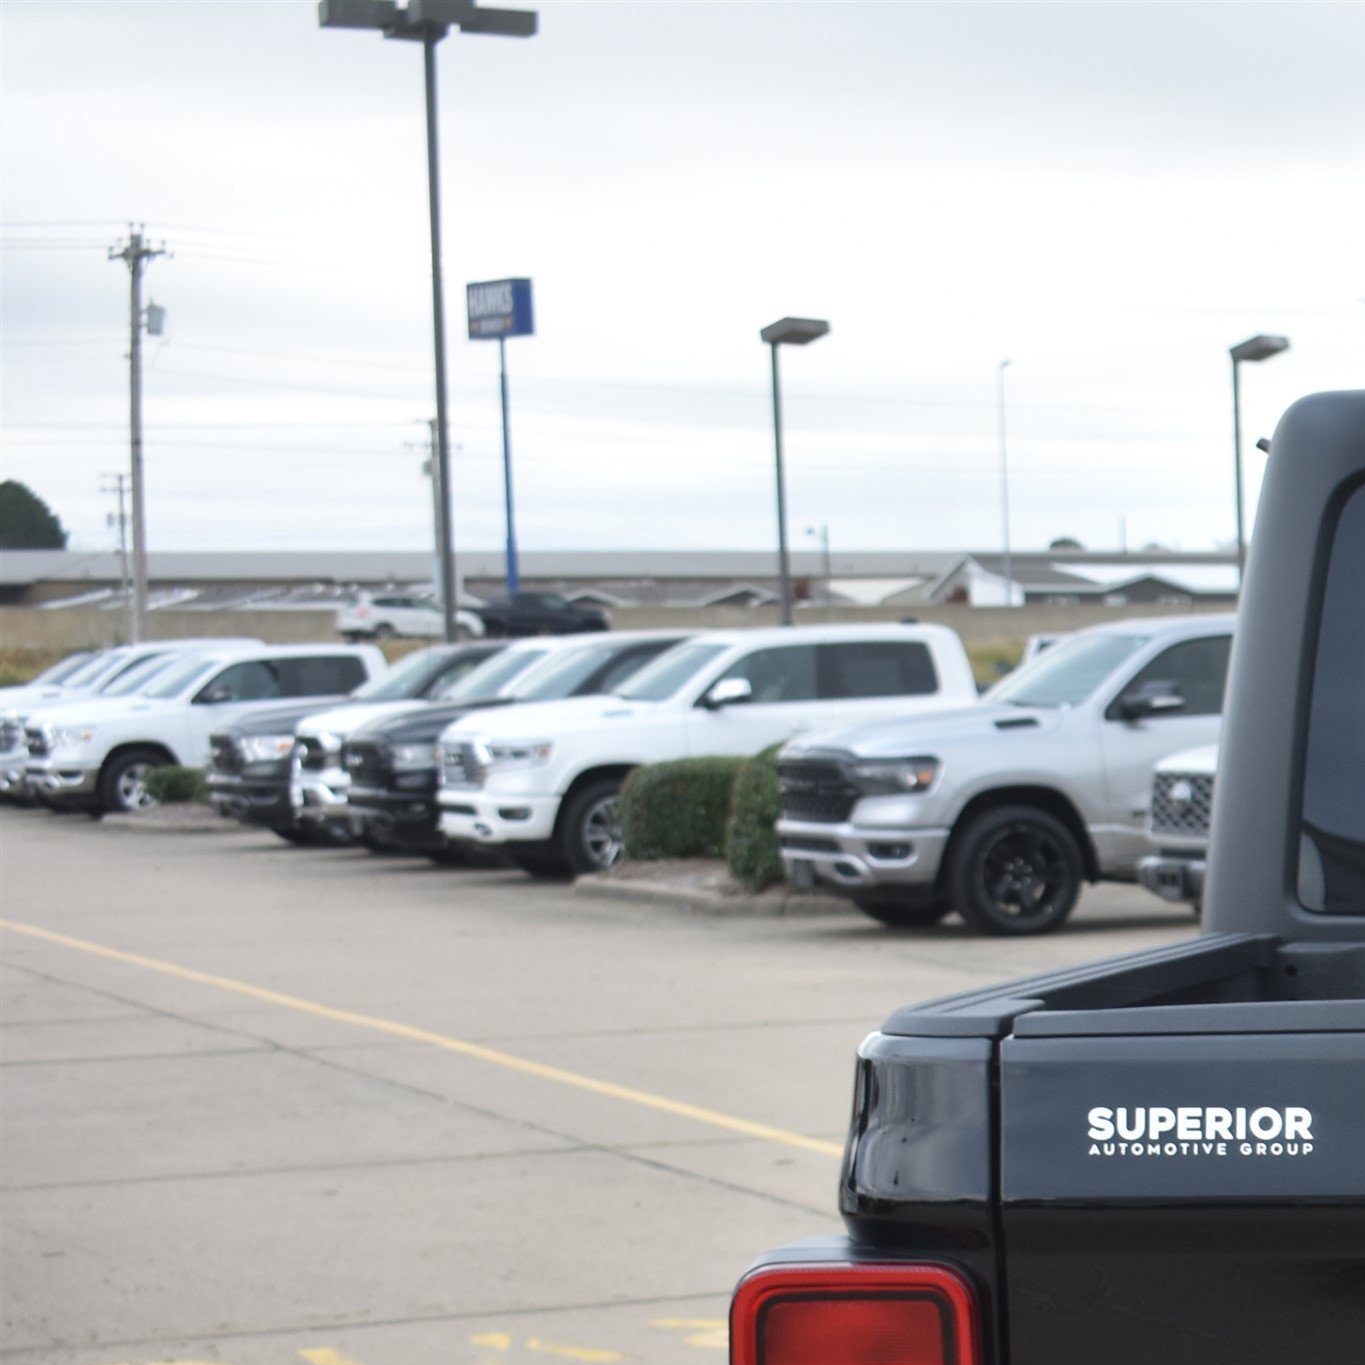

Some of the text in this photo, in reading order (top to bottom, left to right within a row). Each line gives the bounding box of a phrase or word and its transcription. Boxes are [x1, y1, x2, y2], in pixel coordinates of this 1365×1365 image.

[1087, 1106, 1314, 1141] SUPERIOR
[1088, 1142, 1314, 1156] AUTOMOTIVE GROUP
